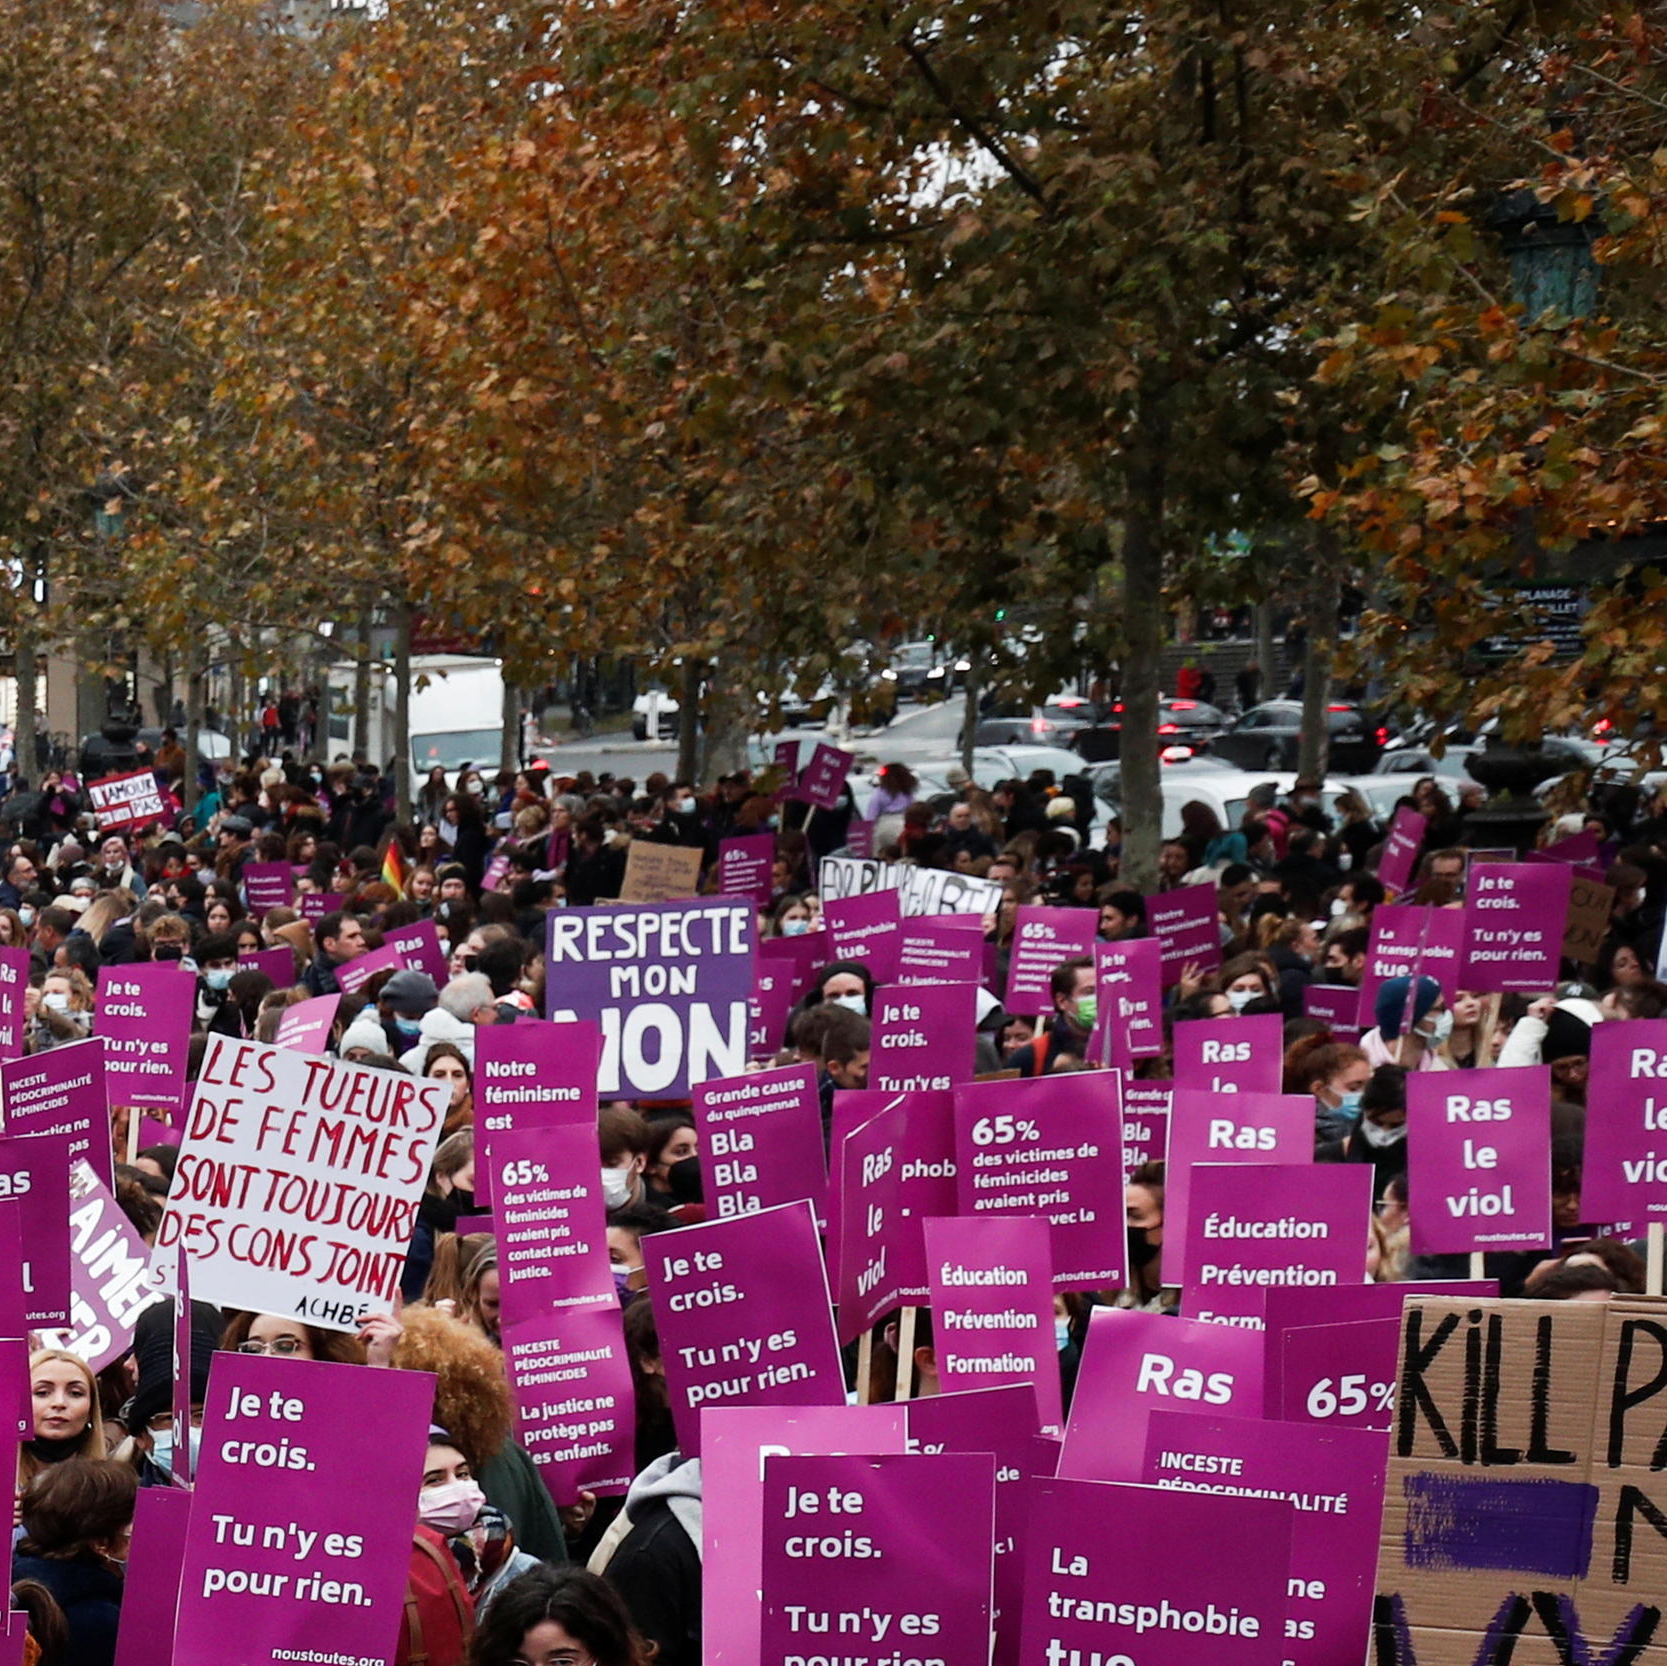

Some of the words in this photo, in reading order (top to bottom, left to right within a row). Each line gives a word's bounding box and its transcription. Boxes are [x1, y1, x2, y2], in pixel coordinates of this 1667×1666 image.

[552, 907, 749, 962] RESPECTE
[610, 964, 697, 998] MON
[203, 1040, 276, 1092] LES
[302, 1060, 440, 1132] TUEURS
[704, 1084, 760, 1105] Grande
[762, 1079, 805, 1095] cause
[1447, 1095, 1512, 1122] Ras
[189, 1097, 243, 1144] DE
[257, 1106, 428, 1185] FEMMES
[711, 1129, 754, 1156] Bla
[1464, 1139, 1497, 1169] le
[715, 1160, 757, 1186] Bla
[170, 1154, 260, 1210] SONT
[263, 1168, 421, 1243] TOUJOURS
[1446, 1185, 1515, 1217] viol
[1204, 1213, 1328, 1238] Éducation
[158, 1210, 225, 1260] DES
[316, 1241, 408, 1301] JOINT
[1201, 1264, 1336, 1286] Prévention
[225, 1387, 261, 1420] Je
[269, 1391, 303, 1421] te
[222, 1438, 315, 1471] crois.
[212, 1515, 255, 1545] Tu
[263, 1523, 318, 1560] n'y
[324, 1534, 363, 1557] es
[1052, 1548, 1088, 1576] La
[203, 1569, 288, 1597] pour
[295, 1572, 371, 1606] rien.
[1048, 1592, 1259, 1637] transphobie
